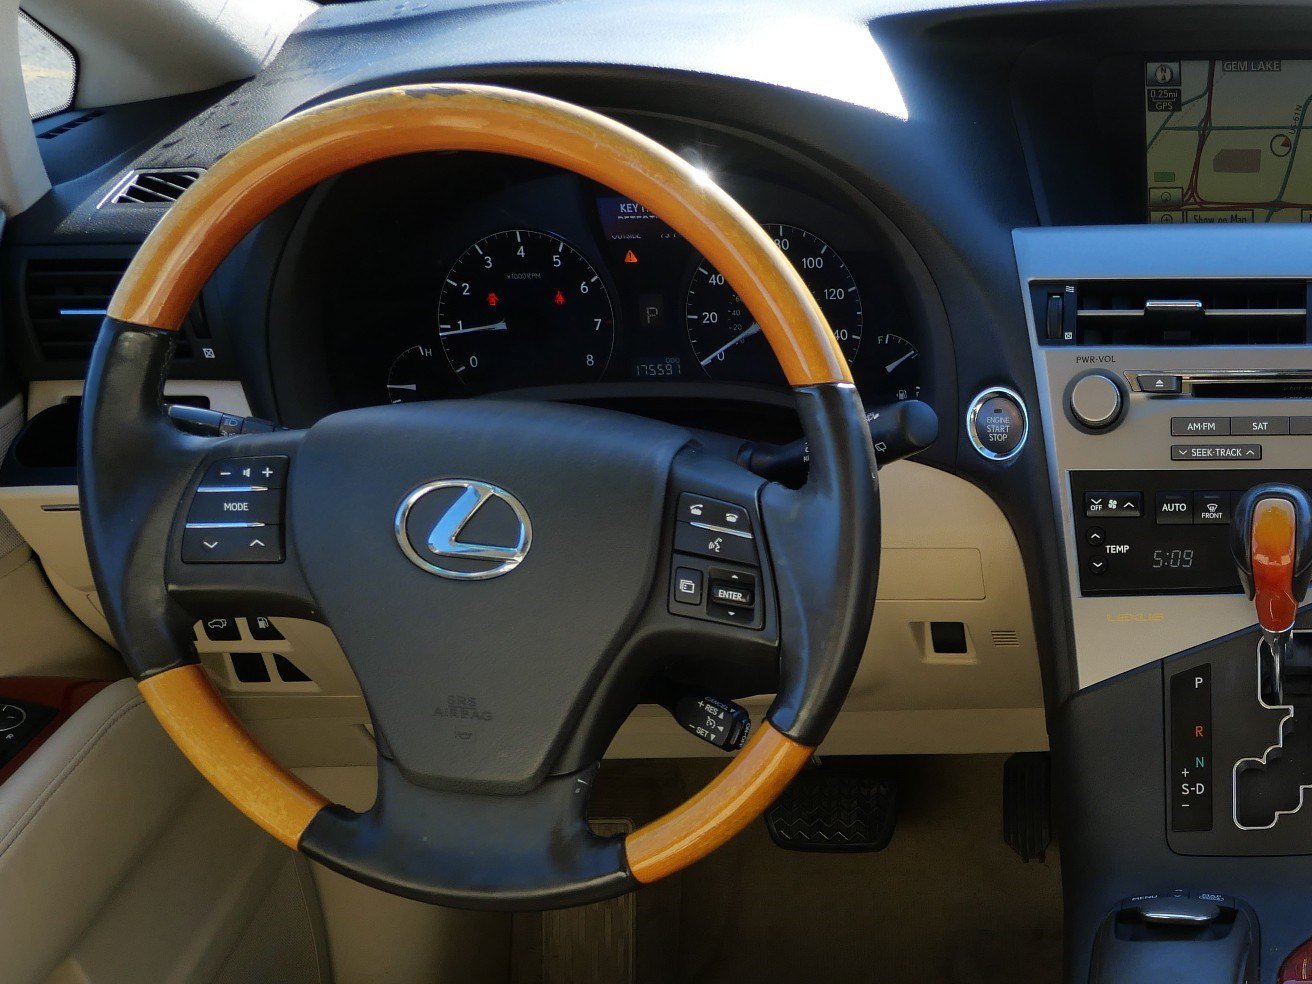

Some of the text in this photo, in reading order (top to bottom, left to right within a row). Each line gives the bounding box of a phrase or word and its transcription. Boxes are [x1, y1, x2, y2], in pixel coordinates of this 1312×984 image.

[1223, 61, 1280, 71] GEM LAKE
[1155, 102, 1174, 111] GPS
[619, 203, 639, 213] KEY
[516, 245, 526, 258] 4
[484, 256, 493, 269] 3
[552, 255, 561, 267] 5
[801, 257, 824, 269] 100
[708, 274, 725, 286] 40
[462, 283, 471, 296] 2
[580, 281, 589, 294] 6
[823, 288, 845, 300] 120
[646, 307, 659, 324] P
[702, 312, 718, 324] 20
[593, 318, 602, 331] 7
[877, 335, 884, 344] F
[424, 348, 433, 357] H
[469, 355, 479, 368] 0
[586, 354, 595, 367] 8
[636, 363, 681, 376] 175591
[986, 416, 1010, 424] ENGINE
[986, 425, 1010, 433] START
[1252, 422, 1269, 431] SAT
[989, 433, 1008, 442] STOP
[223, 502, 249, 512] MODE
[1161, 503, 1187, 512] AUTO
[1105, 544, 1130, 554] TEMP
[1152, 549, 1194, 568] 5:09
[718, 589, 743, 601] ENTER
[1106, 612, 1164, 622] LEXUS
[1195, 677, 1204, 689] P
[704, 704, 719, 716] RES
[695, 726, 710, 738] SET
[1195, 725, 1204, 737] R
[1195, 757, 1205, 768] N
